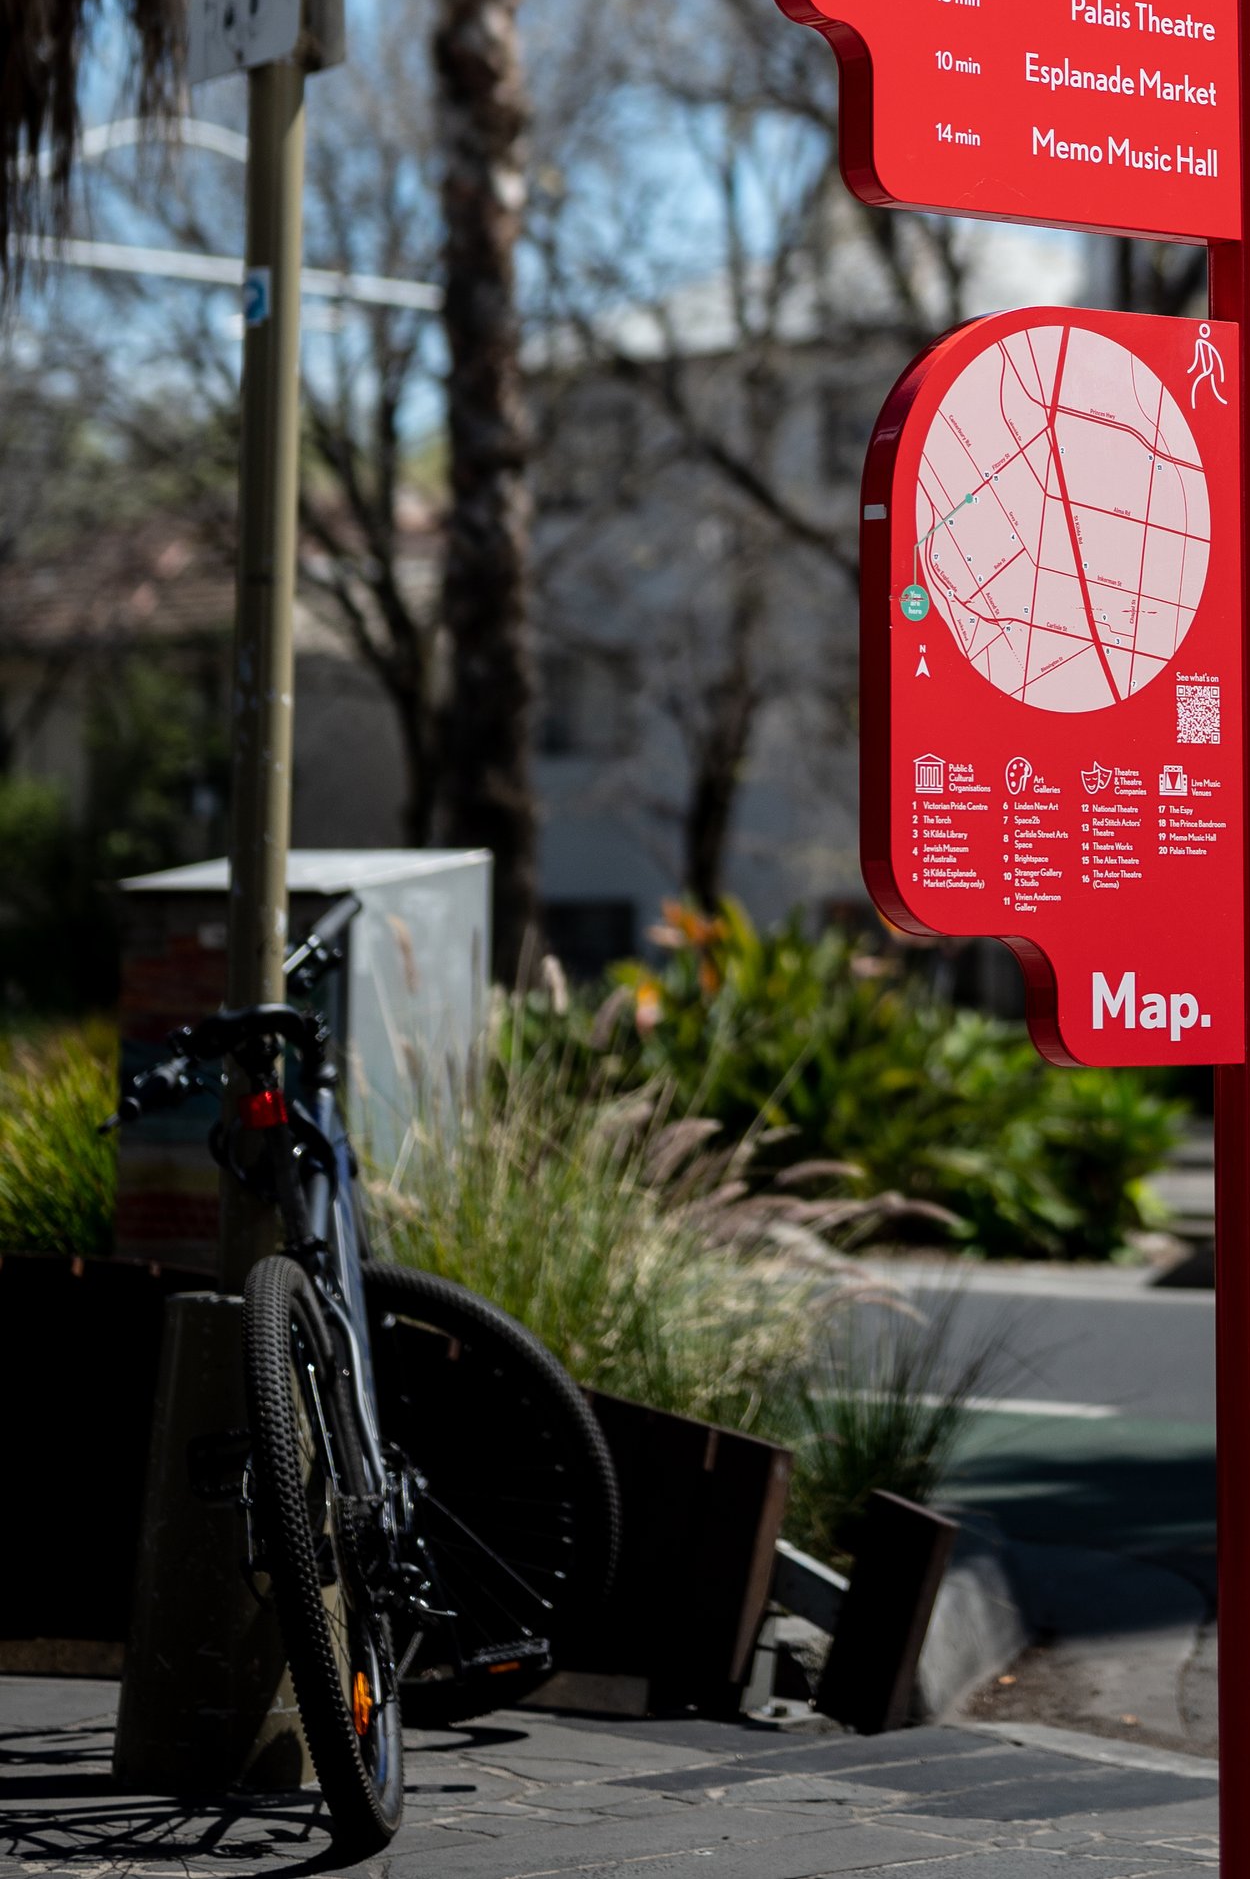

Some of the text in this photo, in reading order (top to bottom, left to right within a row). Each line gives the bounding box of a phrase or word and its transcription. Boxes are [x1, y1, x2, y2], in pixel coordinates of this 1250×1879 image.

[1135, 2, 1215, 40] Theatre
[936, 51, 980, 74] 10 min
[1026, 53, 1216, 106] Esplanade Market
[936, 123, 980, 146] 14 min
[1033, 127, 1217, 177] Memo Music Hall
[920, 645, 926, 653] N
[1176, 672, 1189, 681] See
[1190, 673, 1209, 682] what's
[949, 764, 973, 772] Public &
[1114, 768, 1139, 776] Theatres
[949, 774, 974, 782] Cultural
[1192, 779, 1203, 787] Live
[949, 784, 991, 793] Organisations
[1114, 787, 1146, 796] Companies
[1192, 788, 1211, 796] Venues
[912, 801, 916, 809] 1
[923, 802, 950, 810] Victorian
[951, 802, 966, 810] Pride
[1003, 802, 1008, 810] 6
[1014, 802, 1034, 810] Linden
[1081, 804, 1089, 812] 12
[1117, 805, 1138, 813] Theatre
[1180, 806, 1193, 815] Espy
[913, 815, 918, 823] 2
[935, 816, 951, 824] Torch
[1004, 816, 1040, 825] 7 Space2b
[1093, 818, 1104, 826] Red
[1105, 818, 1122, 826] Stitch
[1159, 819, 1166, 827] 18
[1170, 819, 1180, 827] The
[913, 830, 918, 838] 3
[930, 830, 946, 838] Kilda
[947, 831, 967, 840] Library
[1015, 830, 1037, 838] Carlisle
[1170, 833, 1187, 841] Memo
[923, 844, 943, 852] Jewish
[1015, 840, 1032, 849] Space
[1093, 842, 1114, 850] Theatre
[912, 847, 918, 855] 4
[1015, 855, 1048, 864] Brightspace
[1093, 856, 1103, 864] The
[913, 873, 918, 881] 5
[947, 870, 976, 878] Esplanade
[1004, 872, 1011, 880] 10
[1015, 869, 1062, 878] Stranger Gallery
[1093, 870, 1103, 878] The
[1104, 870, 1120, 878] Astor
[946, 880, 969, 889] (Sunday
[970, 880, 985, 889] only)
[1093, 880, 1119, 889] (Cinema)
[1004, 897, 1010, 905] 11
[1015, 903, 1037, 912] Gallery
[1093, 972, 1210, 1041] Map.
